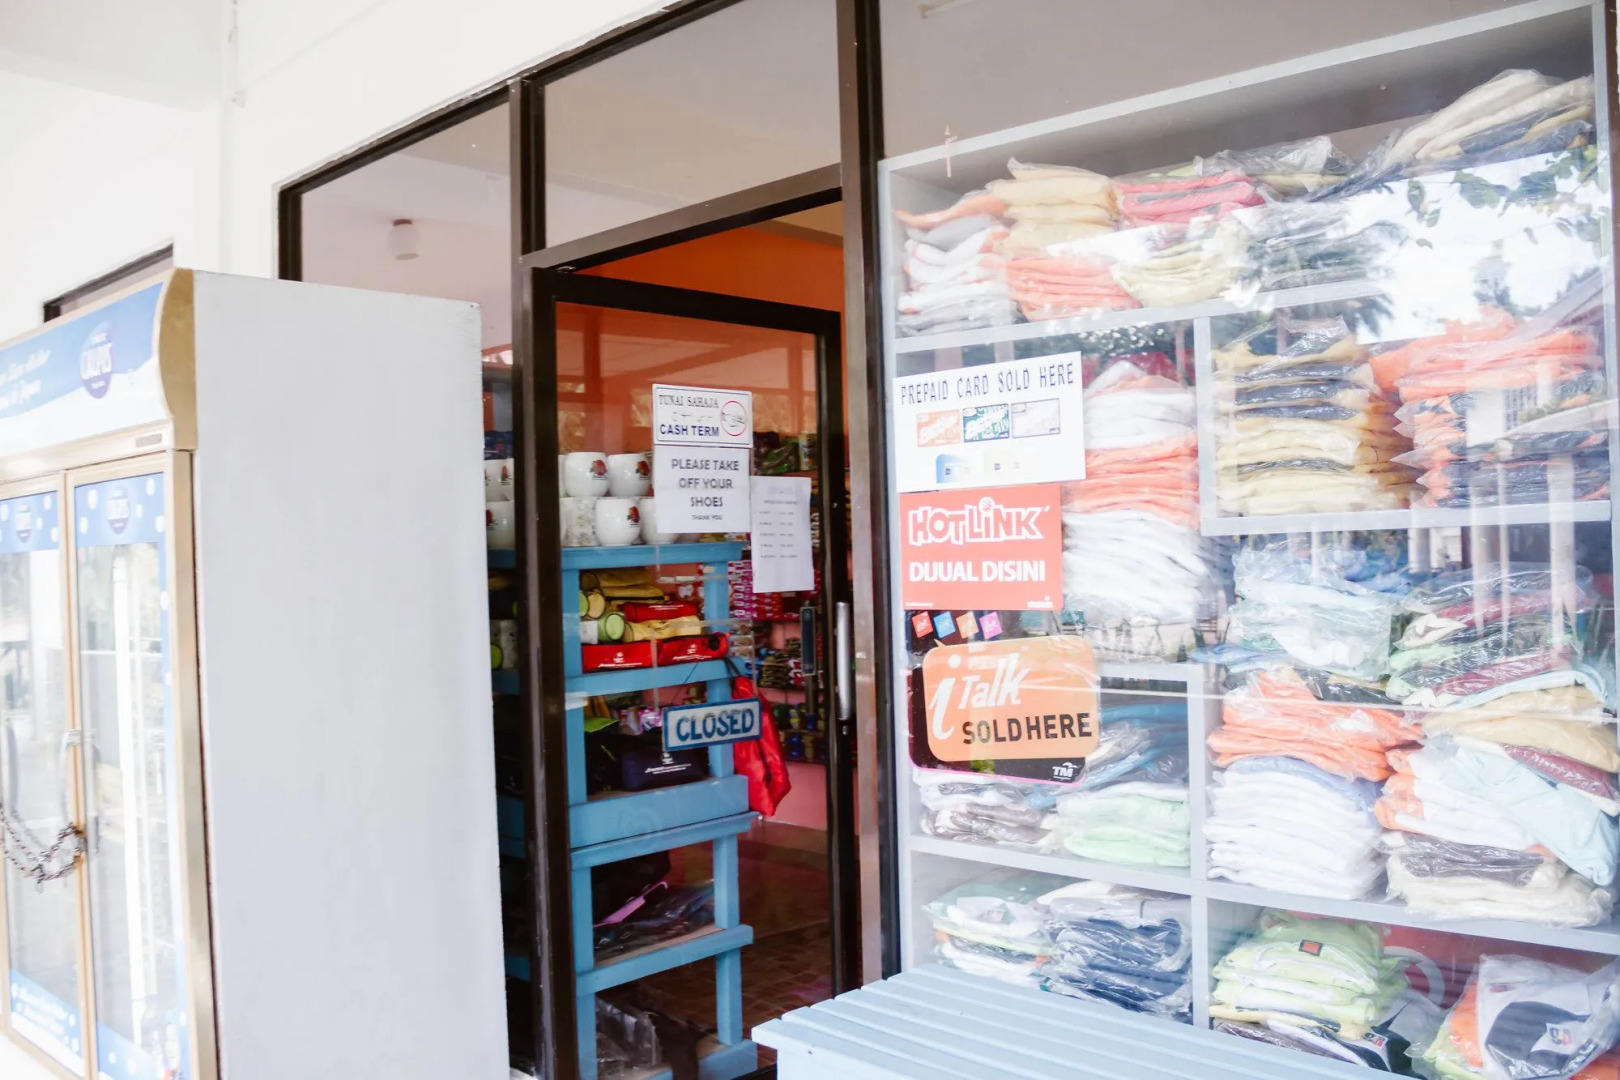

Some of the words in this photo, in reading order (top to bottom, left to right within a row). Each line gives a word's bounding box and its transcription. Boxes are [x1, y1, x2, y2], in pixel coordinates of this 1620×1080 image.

[901, 379, 949, 406] PREPAID
[956, 374, 989, 398] CARD
[998, 368, 1030, 393] SOLD
[1039, 361, 1074, 388] HERE
[660, 424, 689, 436] CASH
[691, 425, 720, 437] TERM
[671, 458, 710, 470] PLEASE
[713, 460, 739, 471] TAKE
[678, 478, 700, 489] OFF
[703, 478, 733, 489] YOUR
[690, 496, 724, 508] SHOES
[909, 561, 979, 582] DIJUAL
[981, 560, 1046, 582] DISINI
[675, 708, 755, 742] CLOSED
[961, 718, 1022, 745] SOLD
[1025, 713, 1093, 741] HERE
[1052, 765, 1074, 778] TM
